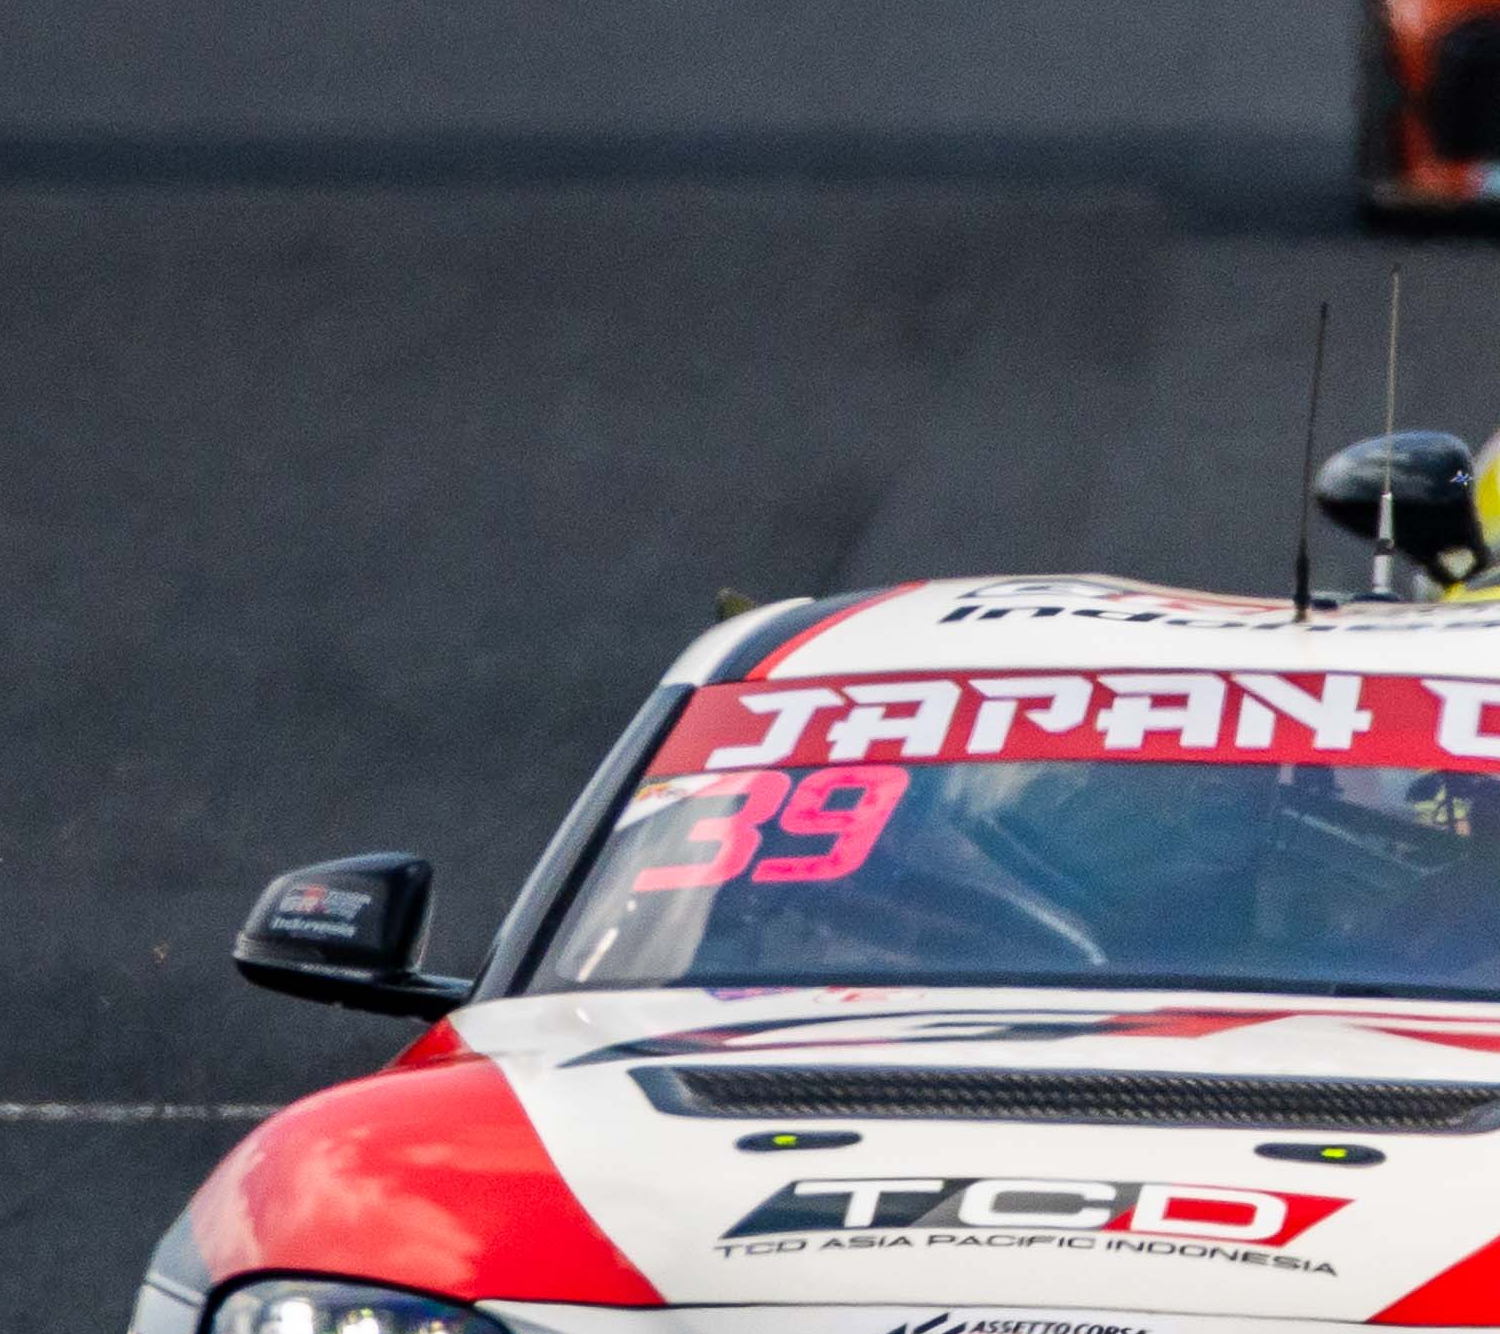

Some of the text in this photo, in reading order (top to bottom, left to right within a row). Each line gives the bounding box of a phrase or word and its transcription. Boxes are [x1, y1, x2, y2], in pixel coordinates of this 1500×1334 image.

[704, 673, 1373, 770] JAPAN
[632, 764, 911, 893] 39
[794, 1178, 1288, 1242] TCD
[714, 1233, 1339, 1277] TCD ASIA PACIFIC INDONESIA
